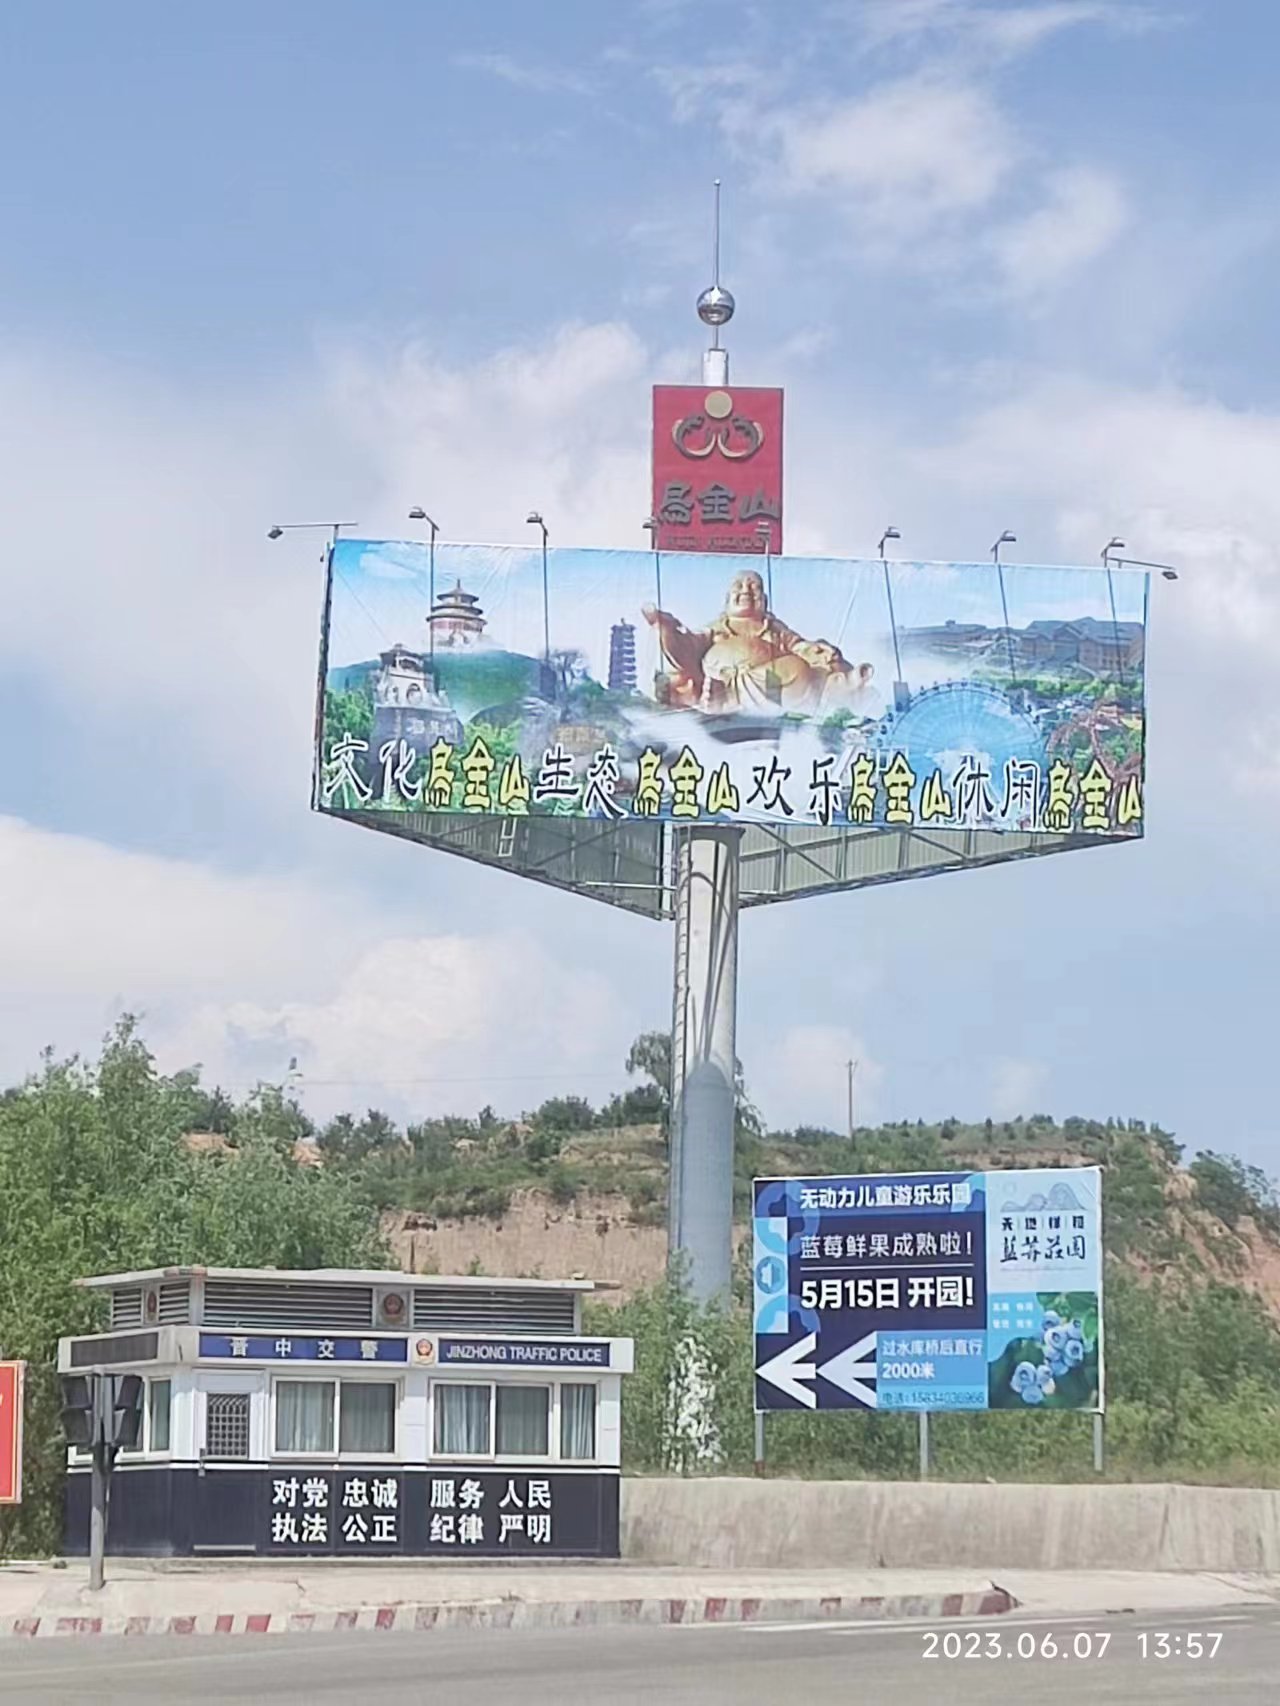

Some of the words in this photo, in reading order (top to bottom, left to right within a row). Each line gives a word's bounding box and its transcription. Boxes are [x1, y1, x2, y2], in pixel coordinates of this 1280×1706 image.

[801, 1279, 899, 1309] 5月15日
[446, 1345, 507, 1361] JINZHONG
[510, 1347, 558, 1361] TRAFFIC
[560, 1348, 602, 1362] POLICE
[882, 1361, 935, 1379] 2000米
[272, 1477, 329, 1508] 对党
[342, 1479, 399, 1509] 忠诚
[430, 1479, 485, 1509] 服务
[499, 1480, 552, 1510] 人民
[272, 1512, 328, 1543] 执法
[342, 1513, 398, 1543] 公正
[429, 1514, 484, 1544] 纪律
[499, 1514, 551, 1543] 严明
